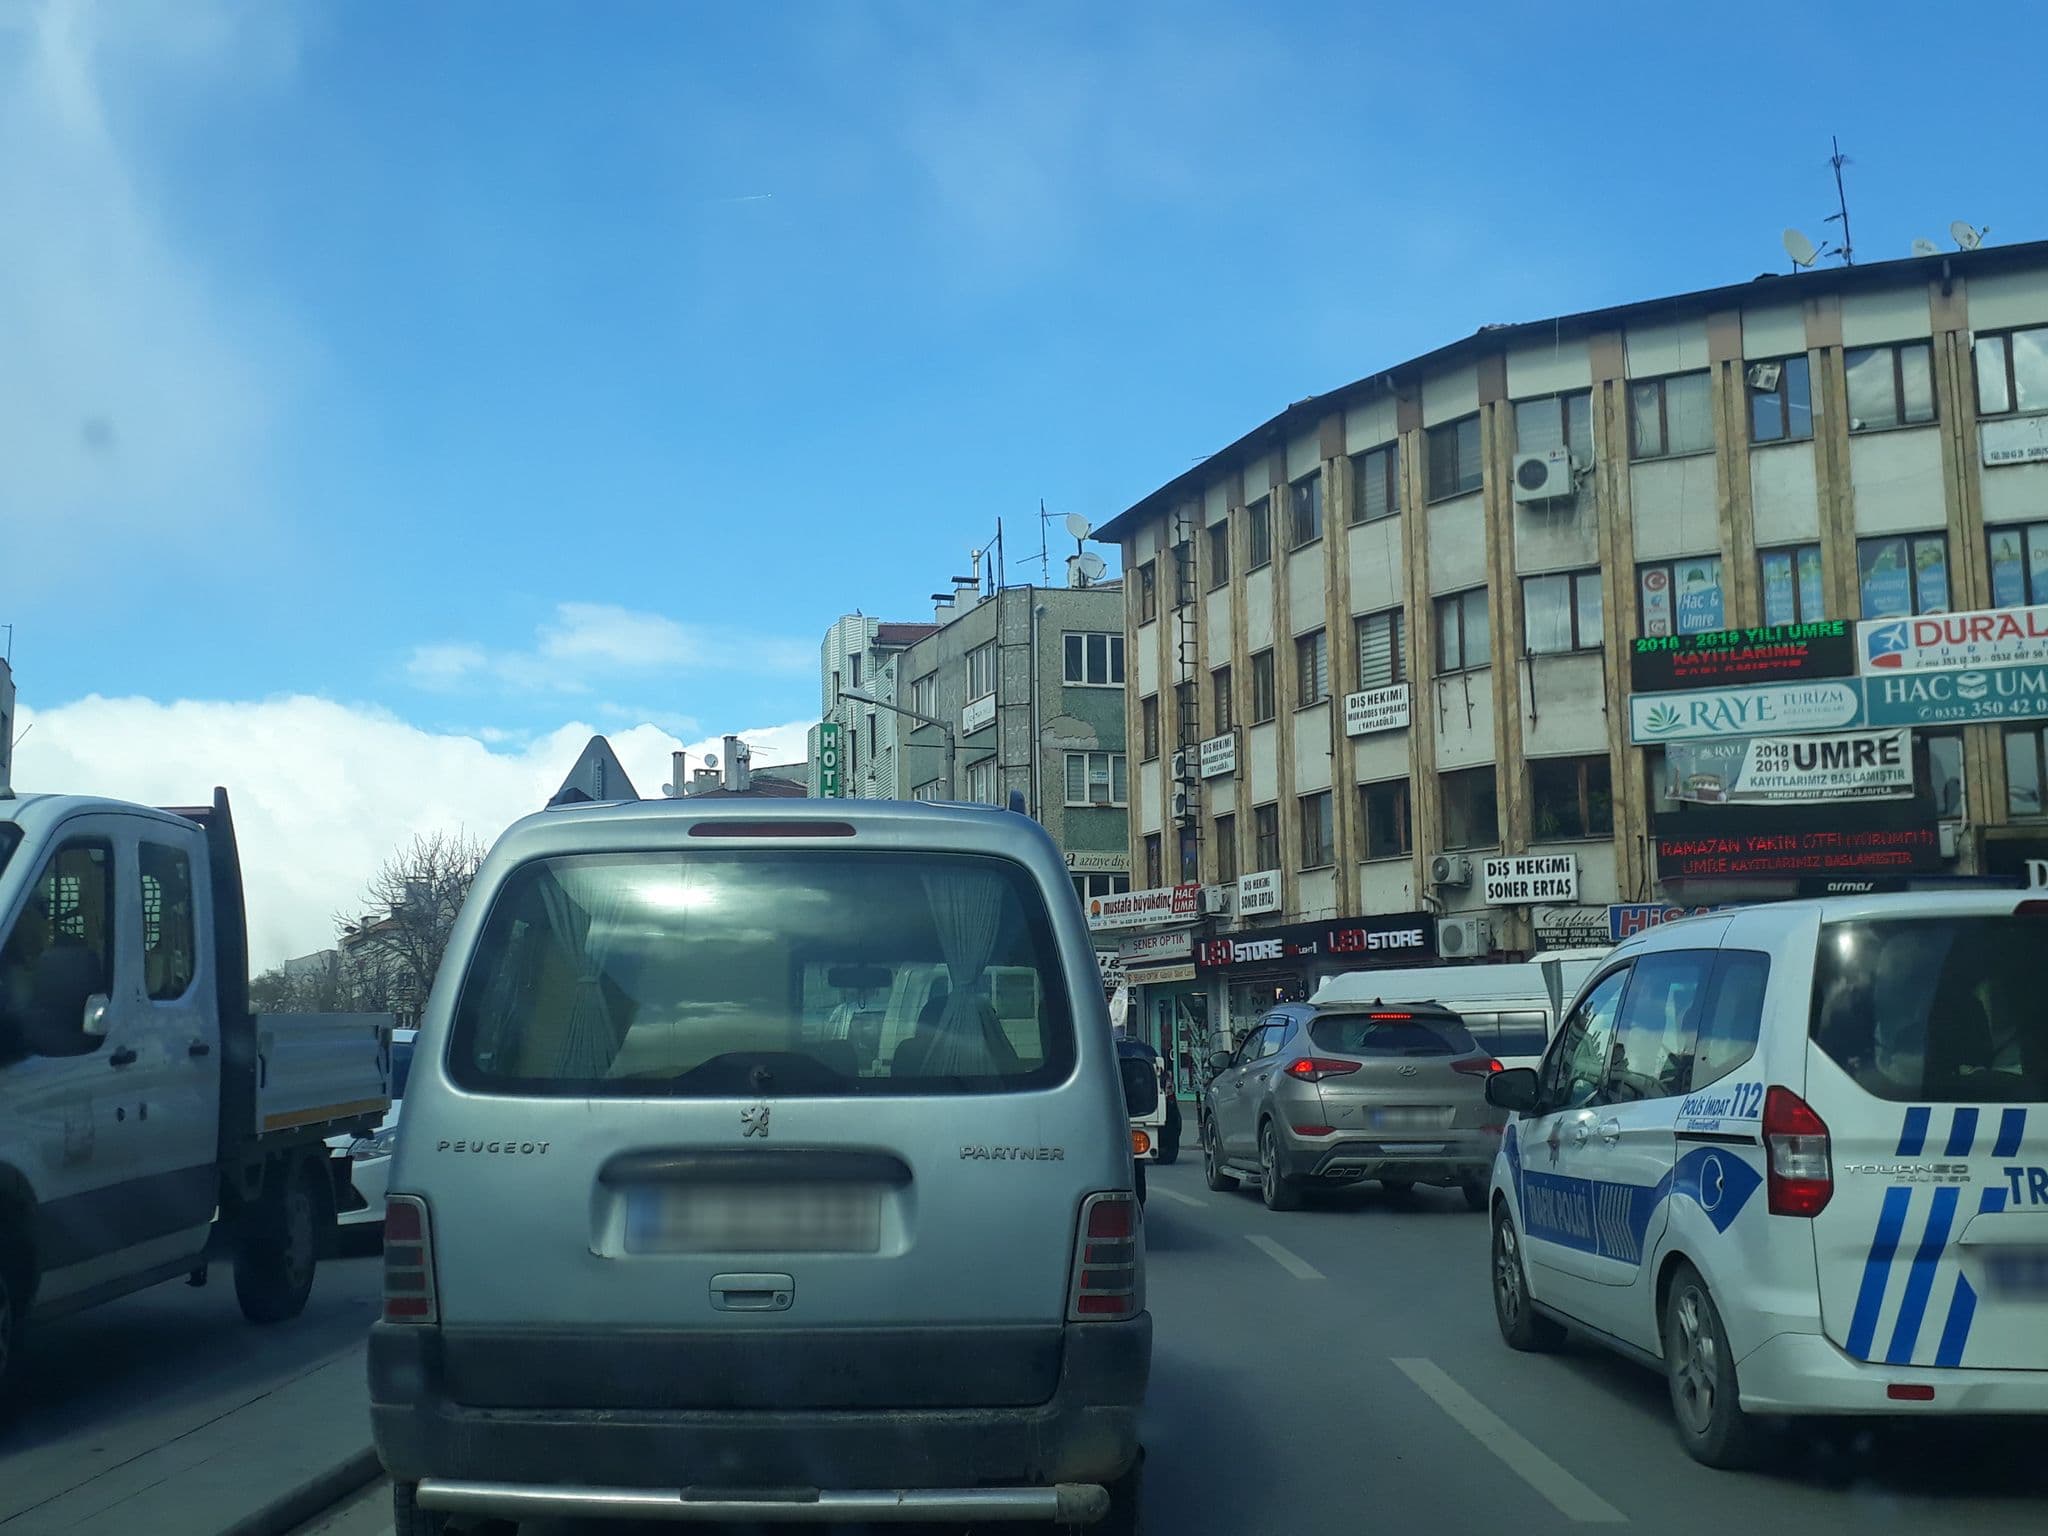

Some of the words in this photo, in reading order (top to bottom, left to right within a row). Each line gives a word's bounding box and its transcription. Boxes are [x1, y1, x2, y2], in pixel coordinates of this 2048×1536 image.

[1682, 594, 1704, 609] Hac
[1683, 614, 1714, 628] Umre
[1914, 612, 2048, 647] DURAL
[1696, 630, 1740, 647] 2019
[1744, 625, 1782, 642] YILI
[1788, 620, 1845, 638] UMRE
[1884, 675, 1952, 704] HAC
[1689, 695, 1777, 731] RAYE
[1971, 701, 2003, 716] 350
[2009, 699, 2031, 714] 42
[1755, 744, 1789, 758] 2018
[1793, 736, 1901, 772] UMRE
[1755, 759, 1790, 773] 2019
[1750, 774, 1828, 788] KAYITLARIMIZ
[1488, 881, 1529, 899] SONER
[1533, 878, 1571, 899] ERTAŞ
[1827, 882, 1875, 892] armas
[1104, 897, 1132, 915] mustafa
[1368, 929, 1424, 950] STORE
[1234, 938, 1283, 963] STORE
[1730, 1082, 1763, 1118] 112
[437, 1140, 550, 1154] PEUGEOT
[959, 1146, 1065, 1161] PARTNER
[1844, 1164, 1969, 1174] TOURNEO
